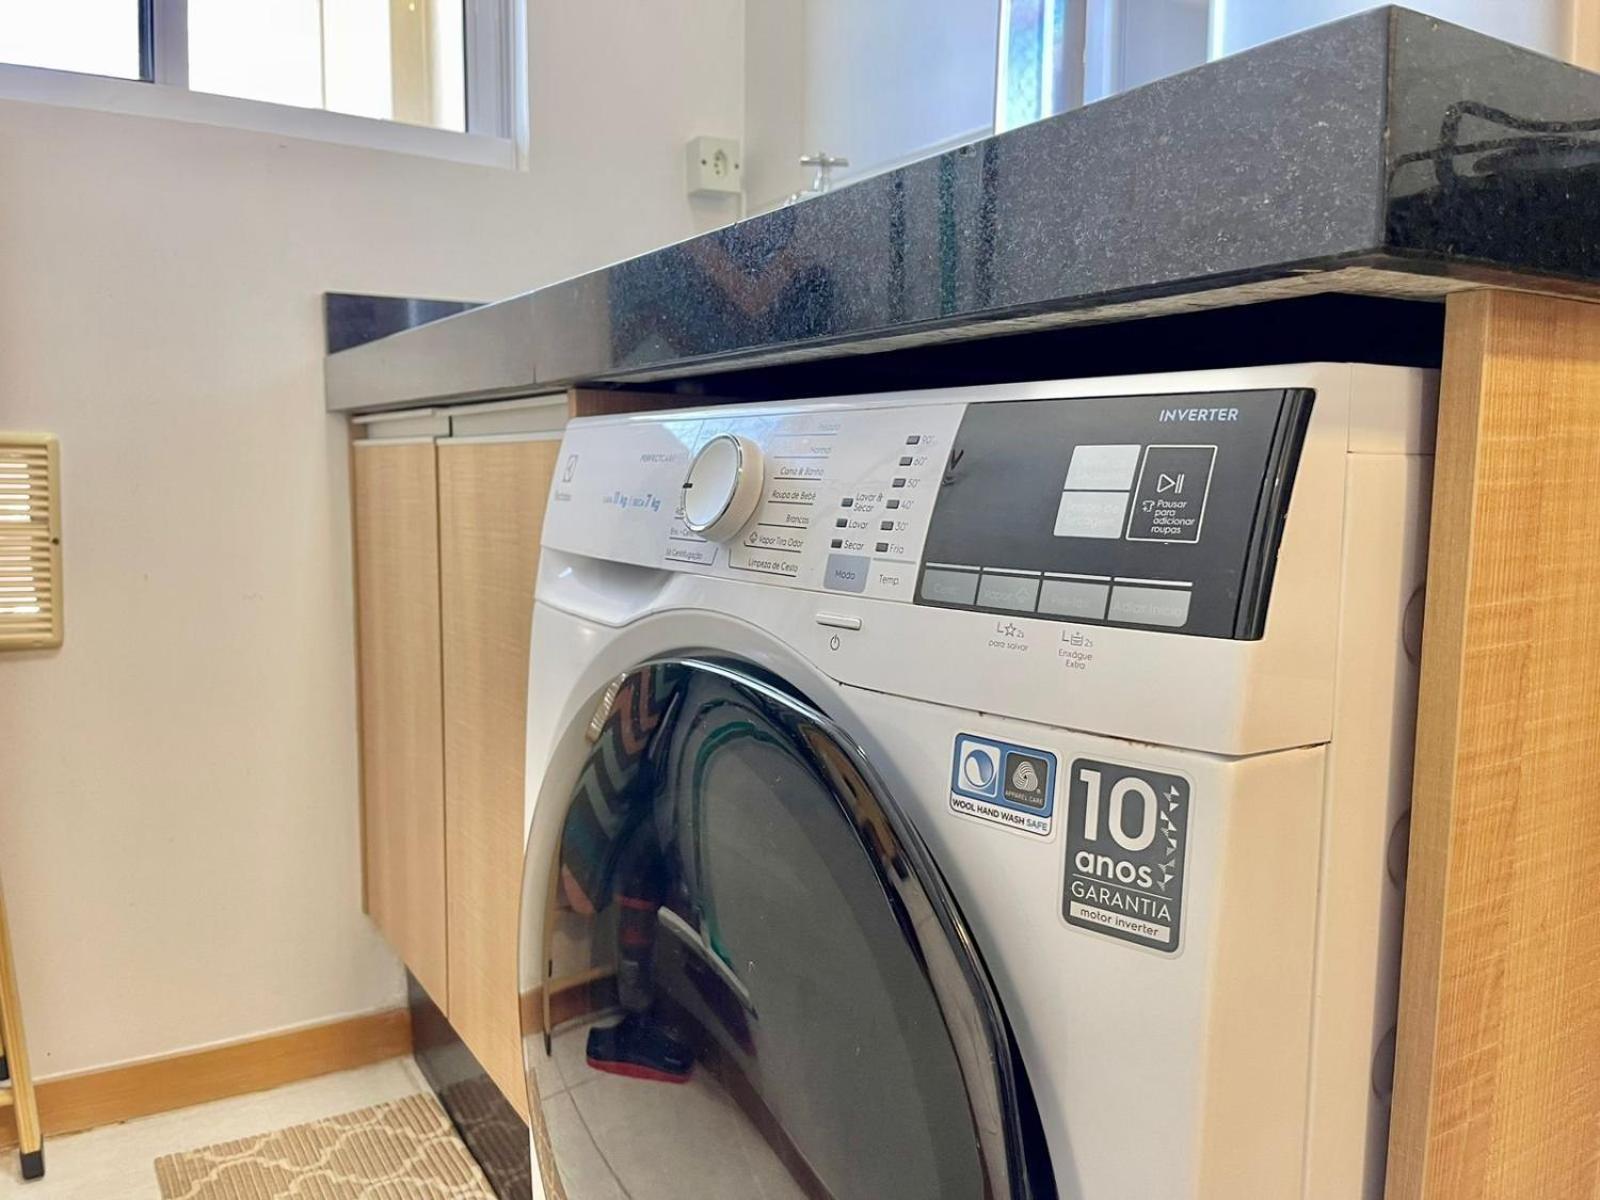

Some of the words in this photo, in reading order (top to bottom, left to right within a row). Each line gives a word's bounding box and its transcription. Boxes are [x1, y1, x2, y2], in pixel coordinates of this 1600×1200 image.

[1158, 408, 1239, 422] INVERTER
[907, 478, 920, 487] 50°
[772, 491, 790, 501] Roupa
[790, 492, 800, 500] de
[856, 493, 876, 502] Lavar
[853, 503, 874, 512] Secar
[900, 500, 914, 509] 40°
[1157, 499, 1187, 509] Pausar
[1154, 508, 1176, 517] para
[785, 514, 810, 525] Brancos
[848, 520, 868, 529] Lavar
[1153, 516, 1195, 526] adicionar
[1151, 525, 1182, 535] roupas
[758, 536, 776, 546] Vapor
[776, 537, 787, 546] Tira
[787, 538, 803, 548] Odor
[844, 540, 864, 550] Secar
[889, 544, 904, 554] Frio
[748, 558, 771, 569] Limpeza
[772, 560, 780, 569] de
[780, 562, 799, 573] Cesto
[834, 569, 856, 580] Modo
[988, 640, 1006, 650] para
[1006, 641, 1029, 652] salvar
[1058, 648, 1093, 661] Enxágue
[1065, 660, 1086, 670] Extra
[953, 798, 976, 813] WOOL
[977, 804, 1000, 819] HAND
[1001, 811, 1025, 825] WASH
[1026, 817, 1048, 831] SAFE
[1079, 768, 1158, 852] 10
[1074, 850, 1154, 889] anos
[1071, 880, 1173, 922] GARANTIA
[1080, 907, 1112, 924] motor
[1115, 914, 1159, 937] inverter
